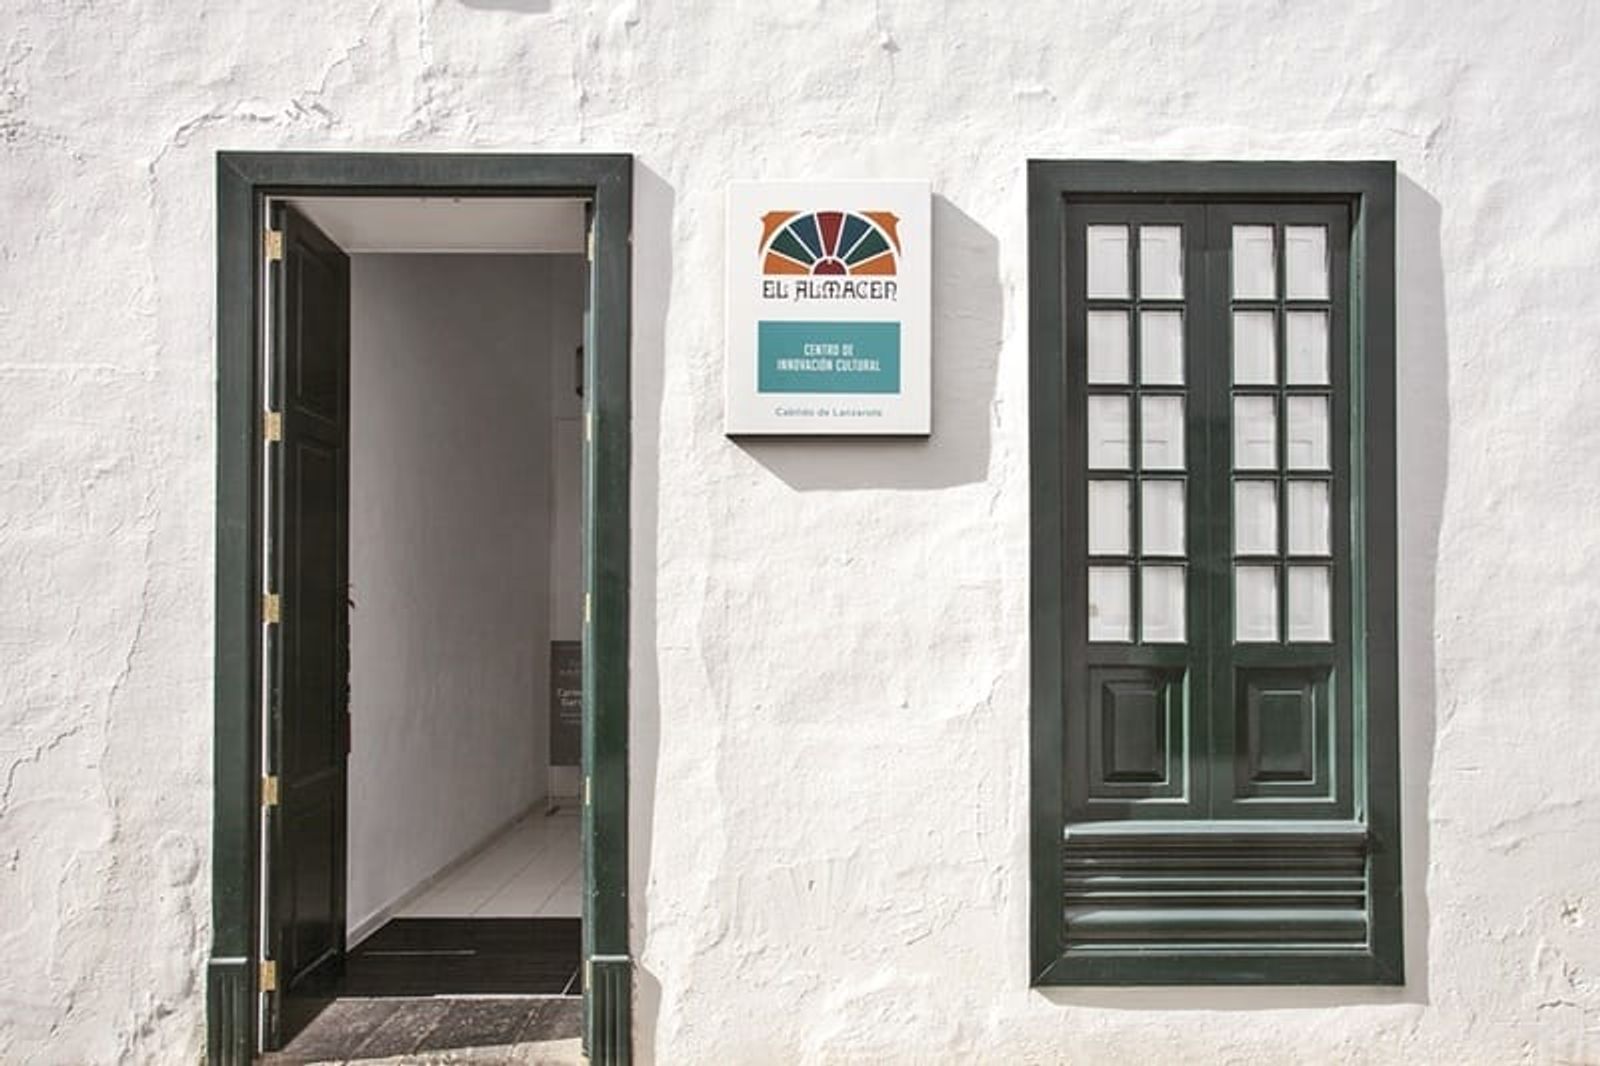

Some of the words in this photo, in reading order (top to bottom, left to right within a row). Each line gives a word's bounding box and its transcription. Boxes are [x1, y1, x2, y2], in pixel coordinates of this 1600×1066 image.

[763, 280, 788, 299] EL
[794, 280, 897, 302] ALMACEN
[804, 343, 839, 356] CENTRO
[842, 343, 854, 356] DE
[835, 359, 881, 372] CULTURAL
